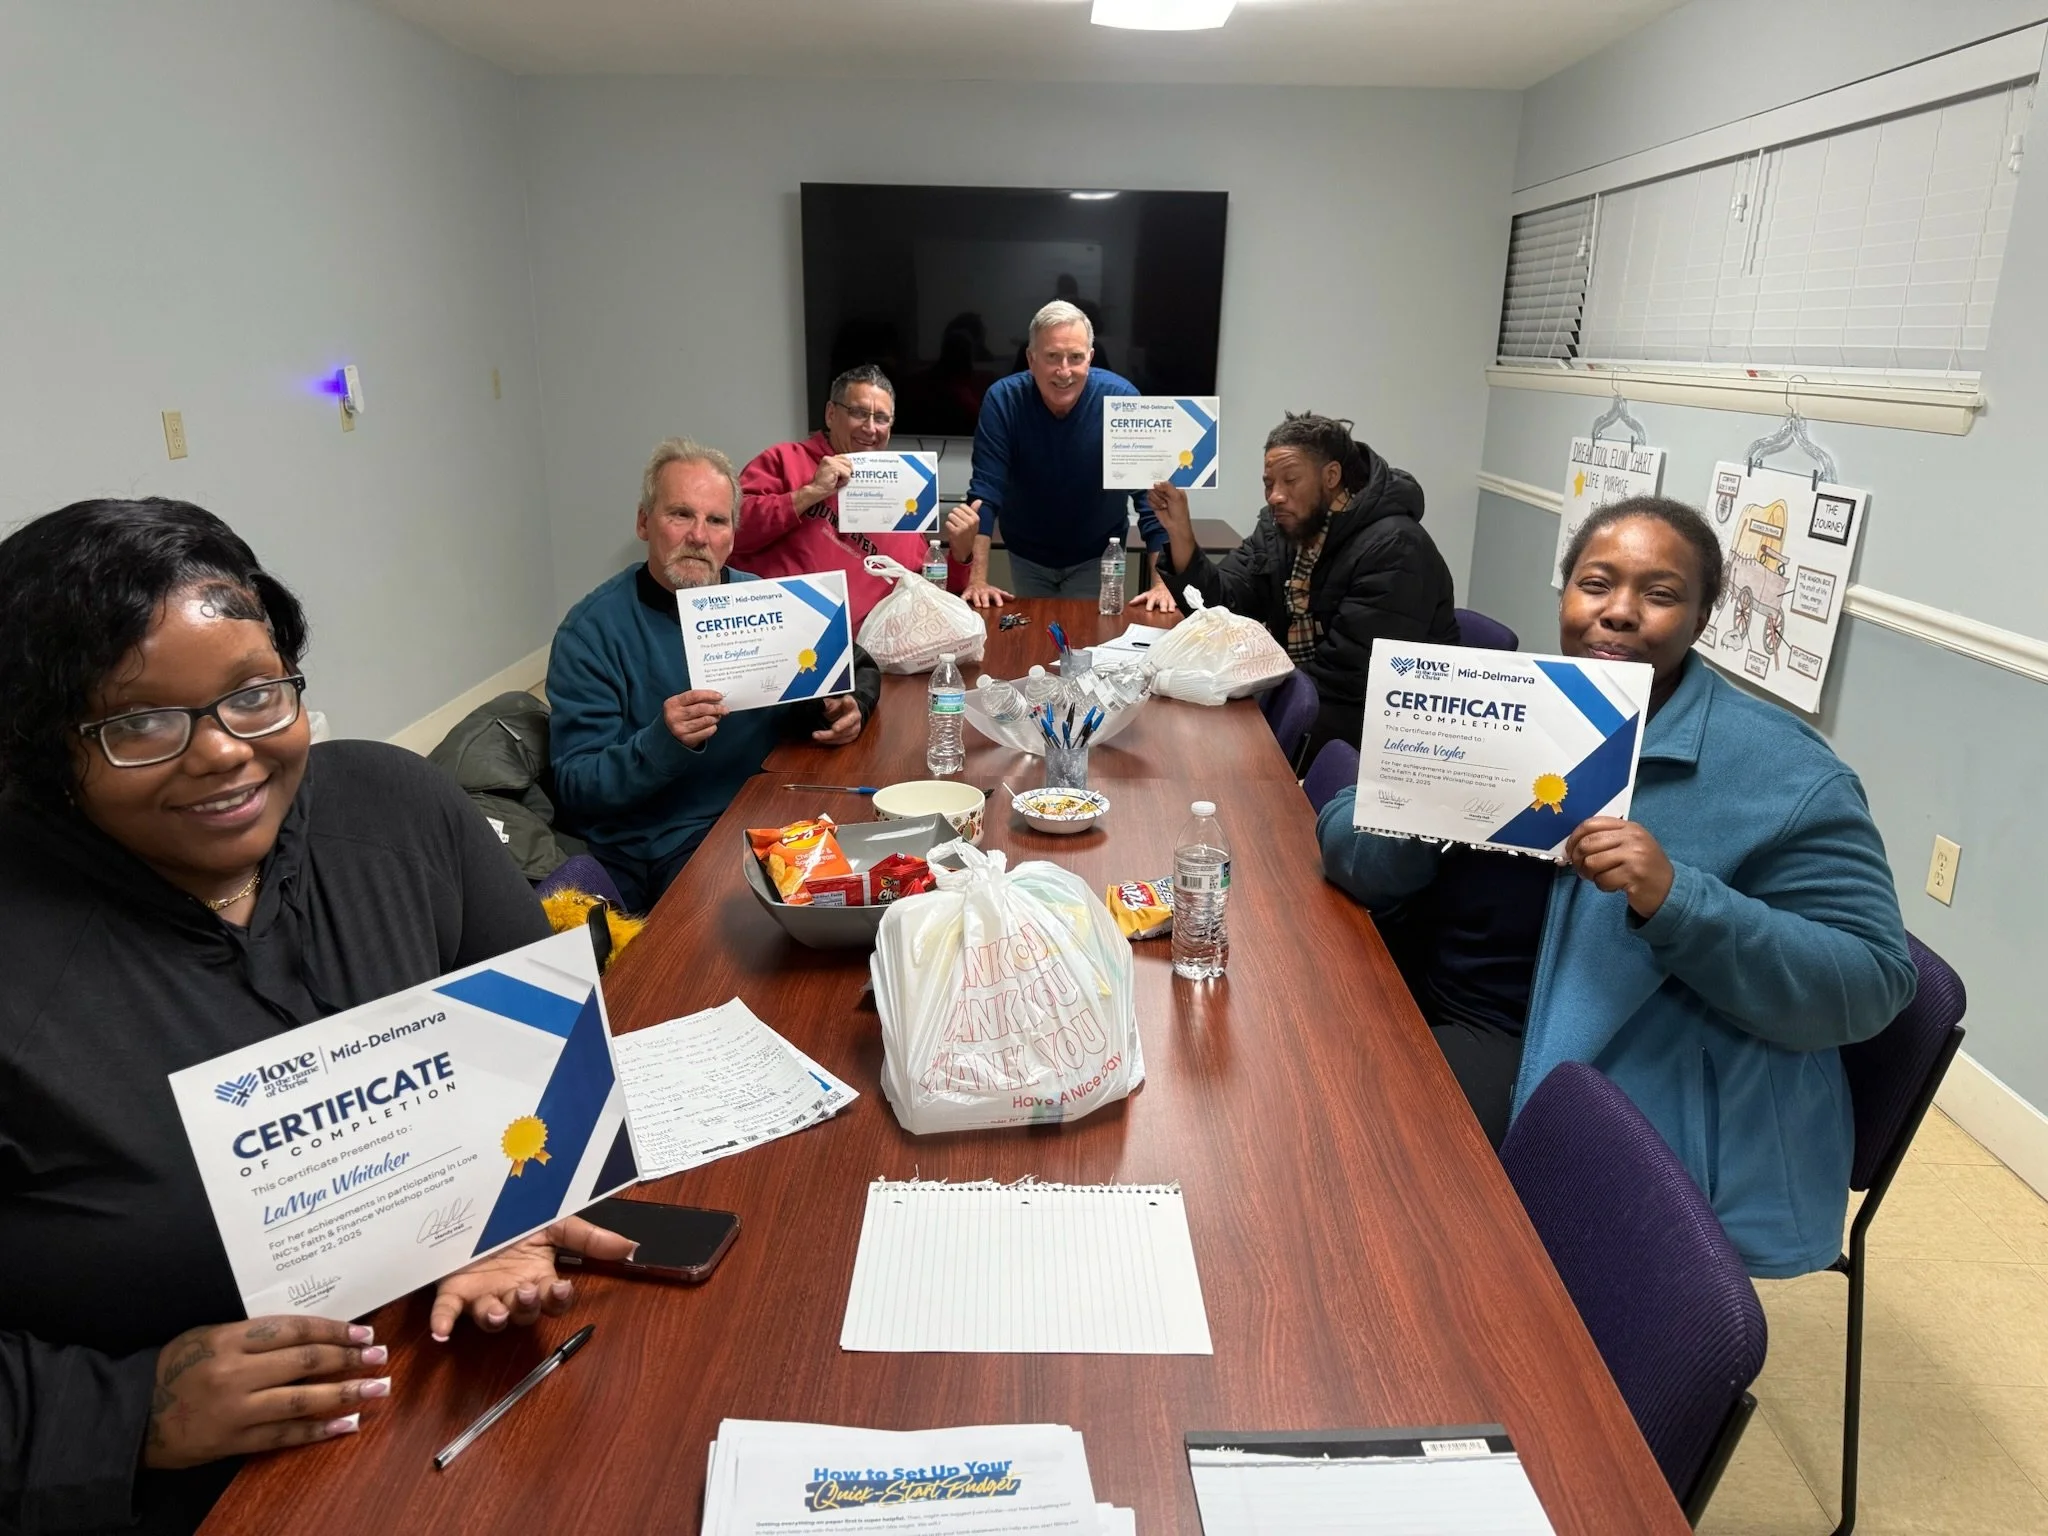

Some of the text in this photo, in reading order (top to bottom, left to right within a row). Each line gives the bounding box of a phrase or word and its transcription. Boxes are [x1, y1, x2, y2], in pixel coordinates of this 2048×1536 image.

[1110, 419, 1172, 428] CERTIFICATE
[1609, 448, 1629, 470] FLOW
[1630, 451, 1654, 474] CHART
[850, 470, 898, 480] ERTIFICATE
[1585, 471, 1628, 495] LIFE PURPOSE
[1825, 504, 1839, 516] THE
[1814, 518, 1846, 533] JOURNEY
[708, 592, 782, 604] love Mid-Delmarva
[696, 611, 784, 632] CERTIFICATE
[716, 626, 784, 638] COMPLETION
[704, 652, 723, 662] Kevin
[1416, 658, 1536, 684] love Mid-Delmarva
[1386, 690, 1527, 722] CERTIFICATE
[1384, 710, 1522, 732] OF COMPLETION
[1386, 724, 1398, 732] This
[1400, 726, 1436, 736] Certificate
[1437, 730, 1474, 742] Presented
[1433, 744, 1466, 762] Voyles
[1380, 774, 1404, 782] October
[1416, 778, 1432, 786] 2025
[1403, 763, 1446, 774] achievements
[1453, 770, 1493, 780] participating
[1418, 772, 1442, 780] Finance
[1442, 776, 1474, 786] Workshop
[256, 1011, 446, 1084] love Mid-Delmarva
[1034, 1008, 1106, 1078] YOU
[264, 1066, 320, 1092] in the name
[266, 1077, 308, 1099] of Christ
[1013, 1051, 1122, 1108] Have A Nice Day
[232, 1052, 454, 1160] CERTIFICATE
[240, 1081, 456, 1178] OF COMPLETION
[251, 1182, 276, 1196] This
[278, 1156, 338, 1186] Certificate
[340, 1130, 395, 1160] Presented
[264, 1152, 410, 1225] LaMya Whitaker
[268, 1153, 478, 1250] For her achievements in participating in Love
[272, 1175, 455, 1262] INC's Faith & Finance Workshop course
[276, 1229, 362, 1272] October 22, 2025
[814, 1460, 1013, 1482] How to Set Up Your
[813, 1474, 1017, 1509] Quick-Start Budget
